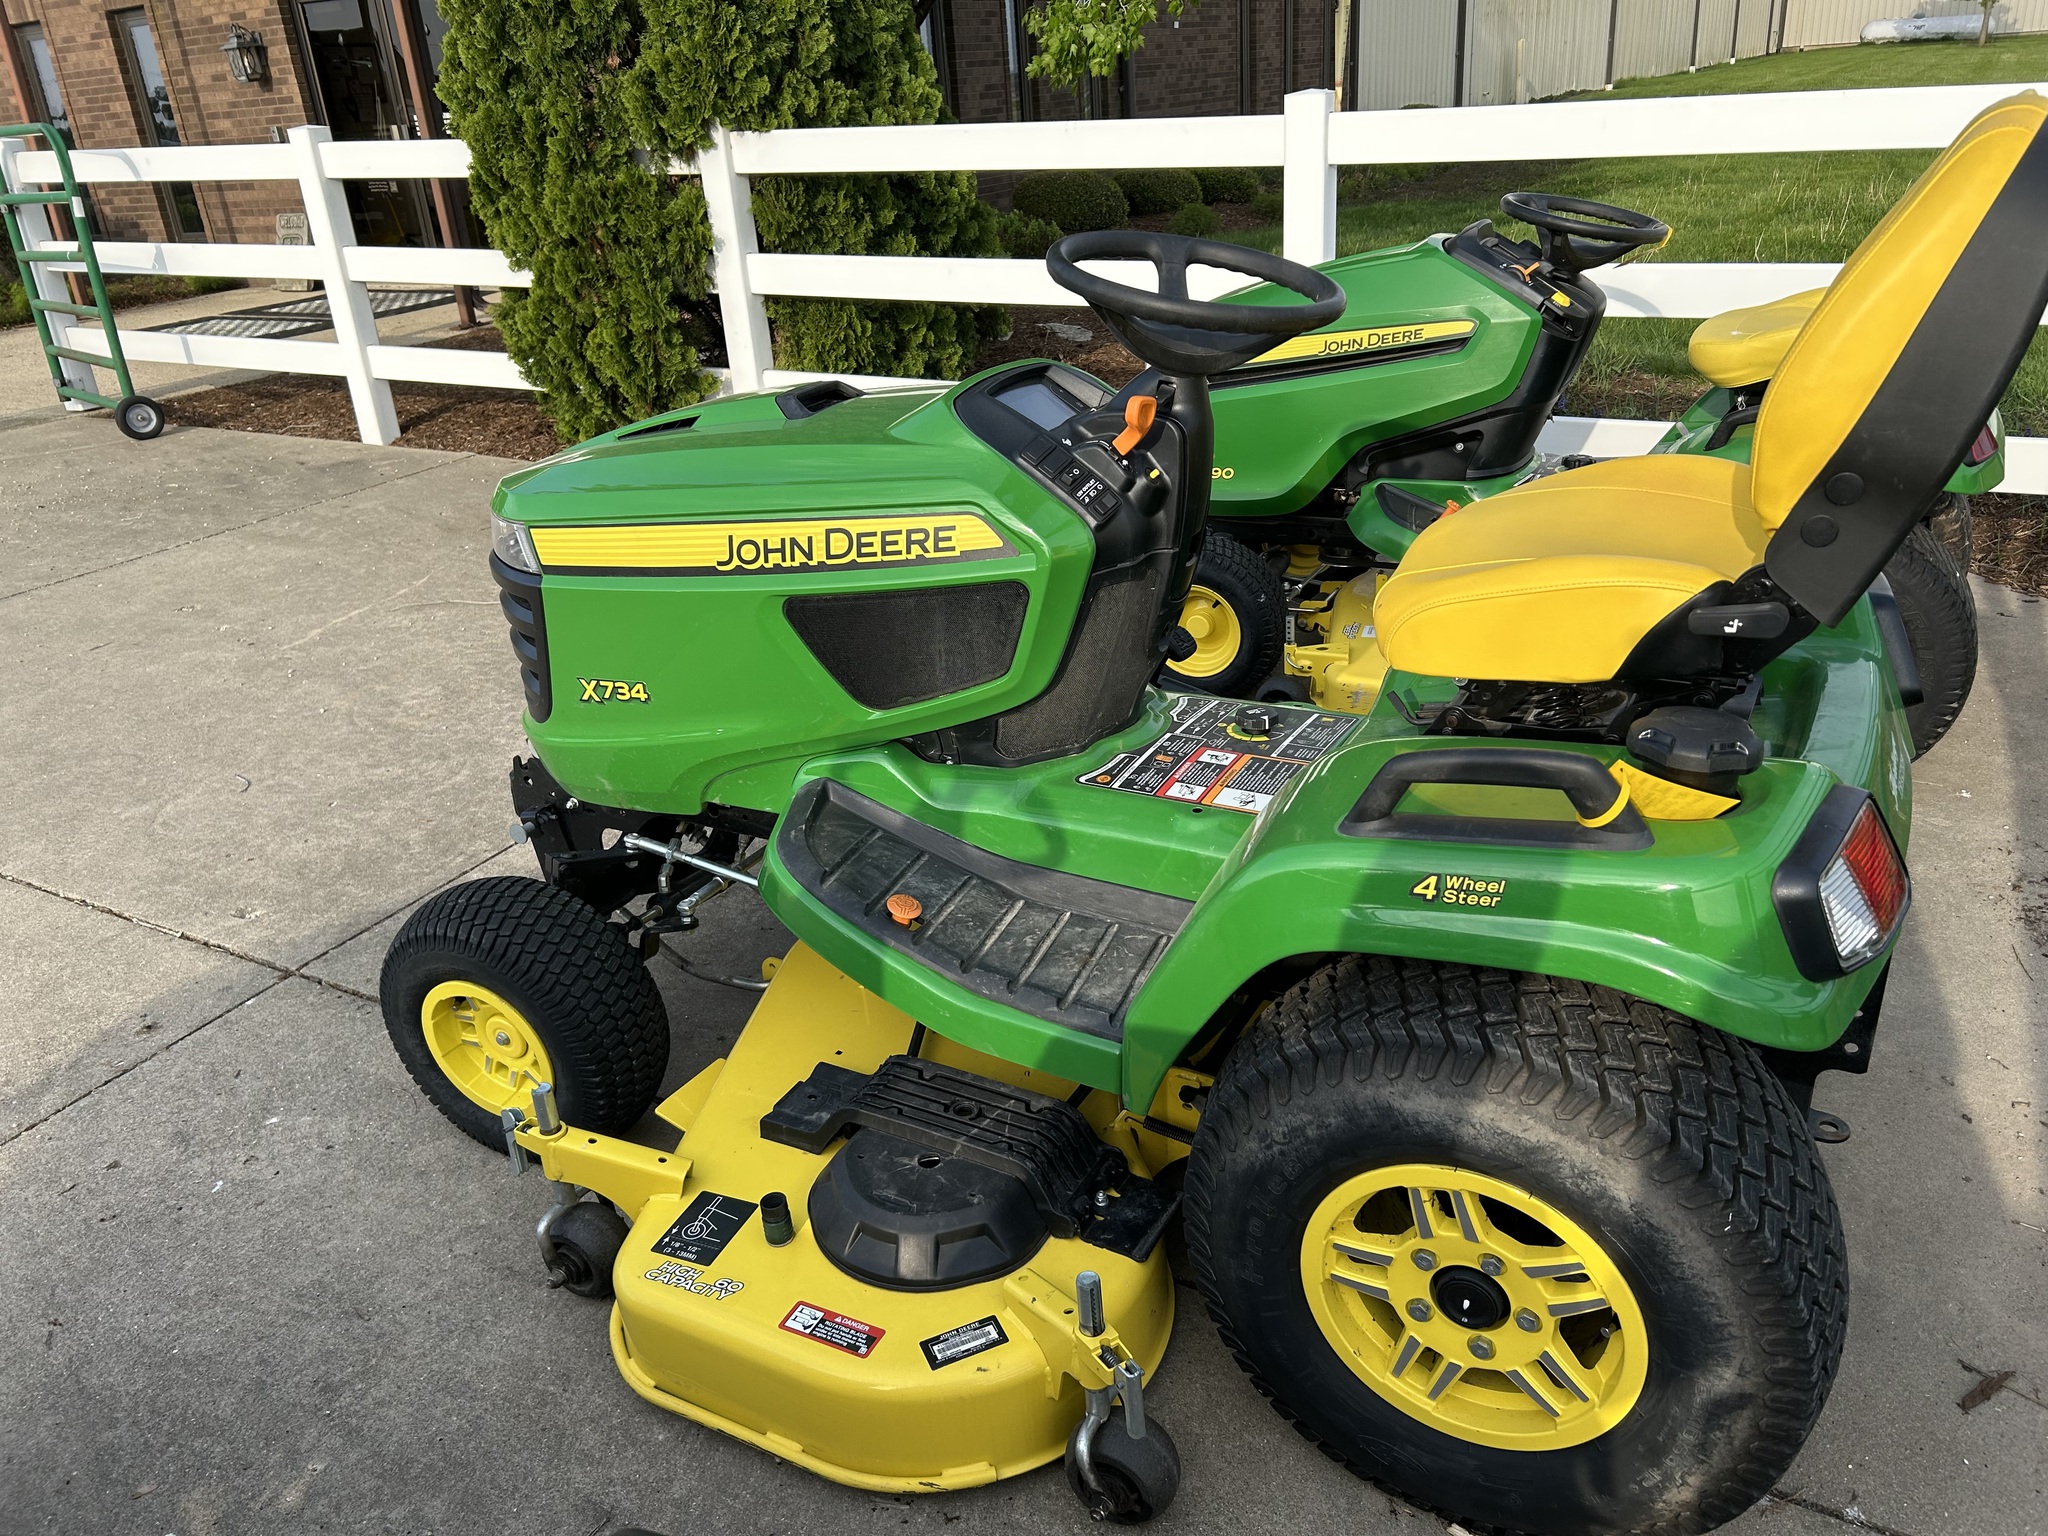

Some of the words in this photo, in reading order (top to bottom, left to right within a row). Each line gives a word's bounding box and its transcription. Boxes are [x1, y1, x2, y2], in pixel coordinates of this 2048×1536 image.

[1318, 337, 1364, 355] JOHN
[1367, 328, 1425, 347] DEERE
[1211, 467, 1235, 479] 90
[716, 533, 815, 568] JOHN
[824, 524, 958, 561] DEERE
[577, 678, 649, 703] X734
[1411, 874, 1439, 902] 4
[1445, 874, 1506, 894] Wheel
[1442, 888, 1502, 908] Steer
[657, 1260, 705, 1280] HIGH
[644, 1269, 735, 1300] CAPACITY
[713, 1277, 745, 1293] 60
[841, 1318, 870, 1332] DANGER
[940, 1329, 957, 1340] JOHN
[958, 1322, 980, 1333] DEERE
